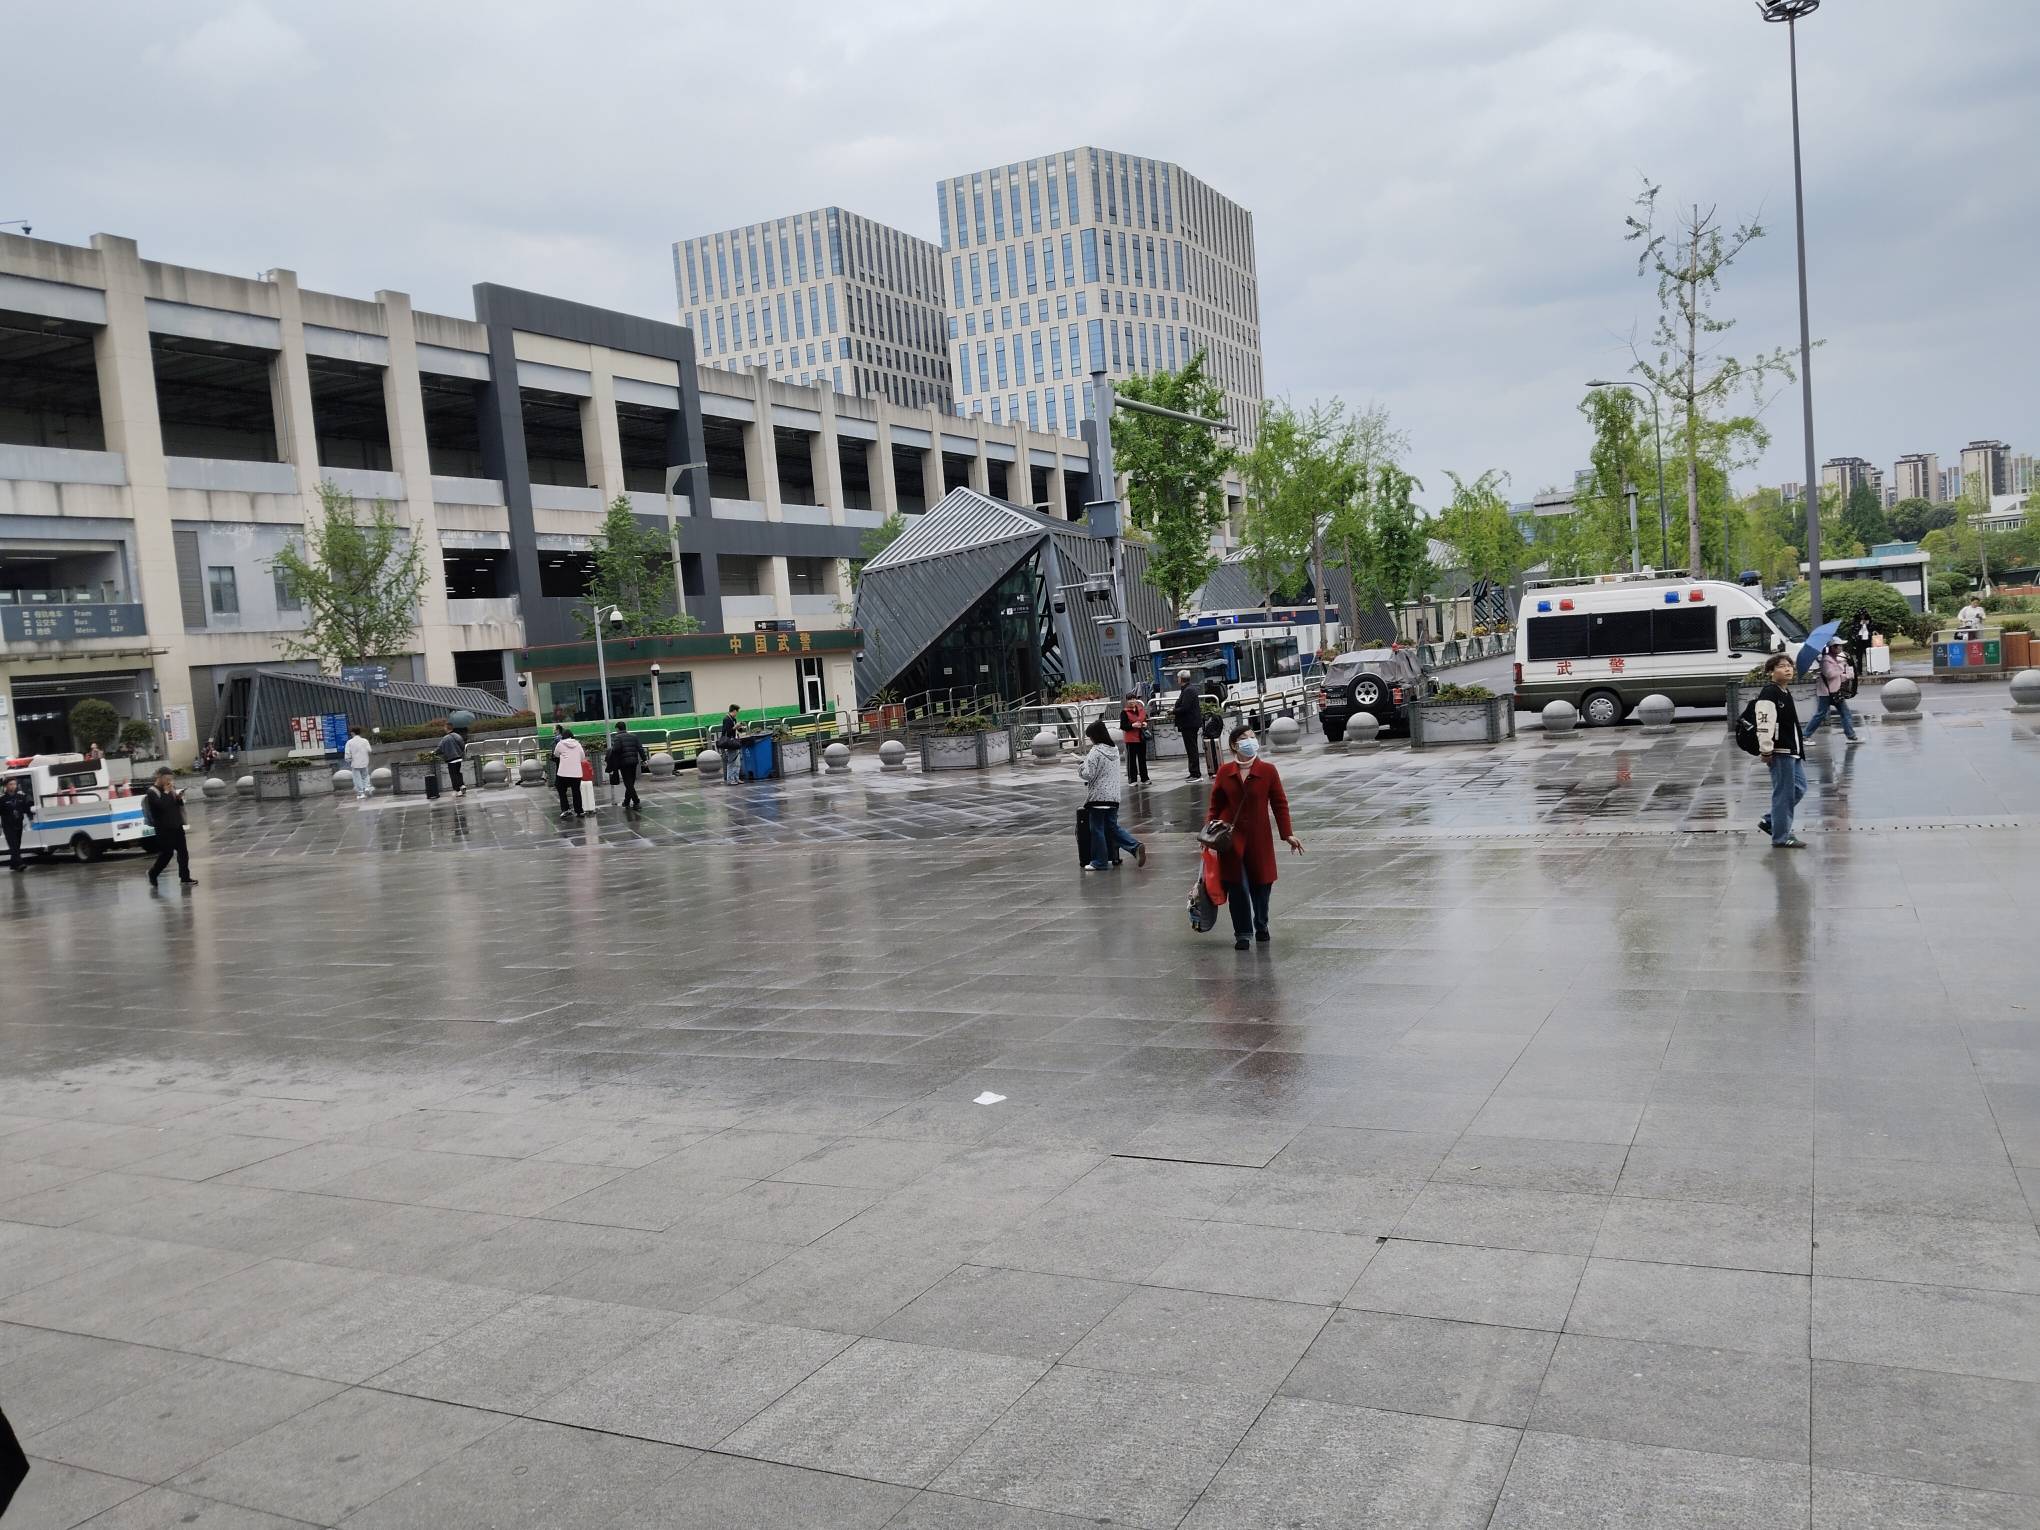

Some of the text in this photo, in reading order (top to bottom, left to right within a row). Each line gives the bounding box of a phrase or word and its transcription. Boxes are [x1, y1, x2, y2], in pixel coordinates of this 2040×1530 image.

[729, 631, 811, 655] 中国武警
[1556, 656, 1625, 676] 武警
